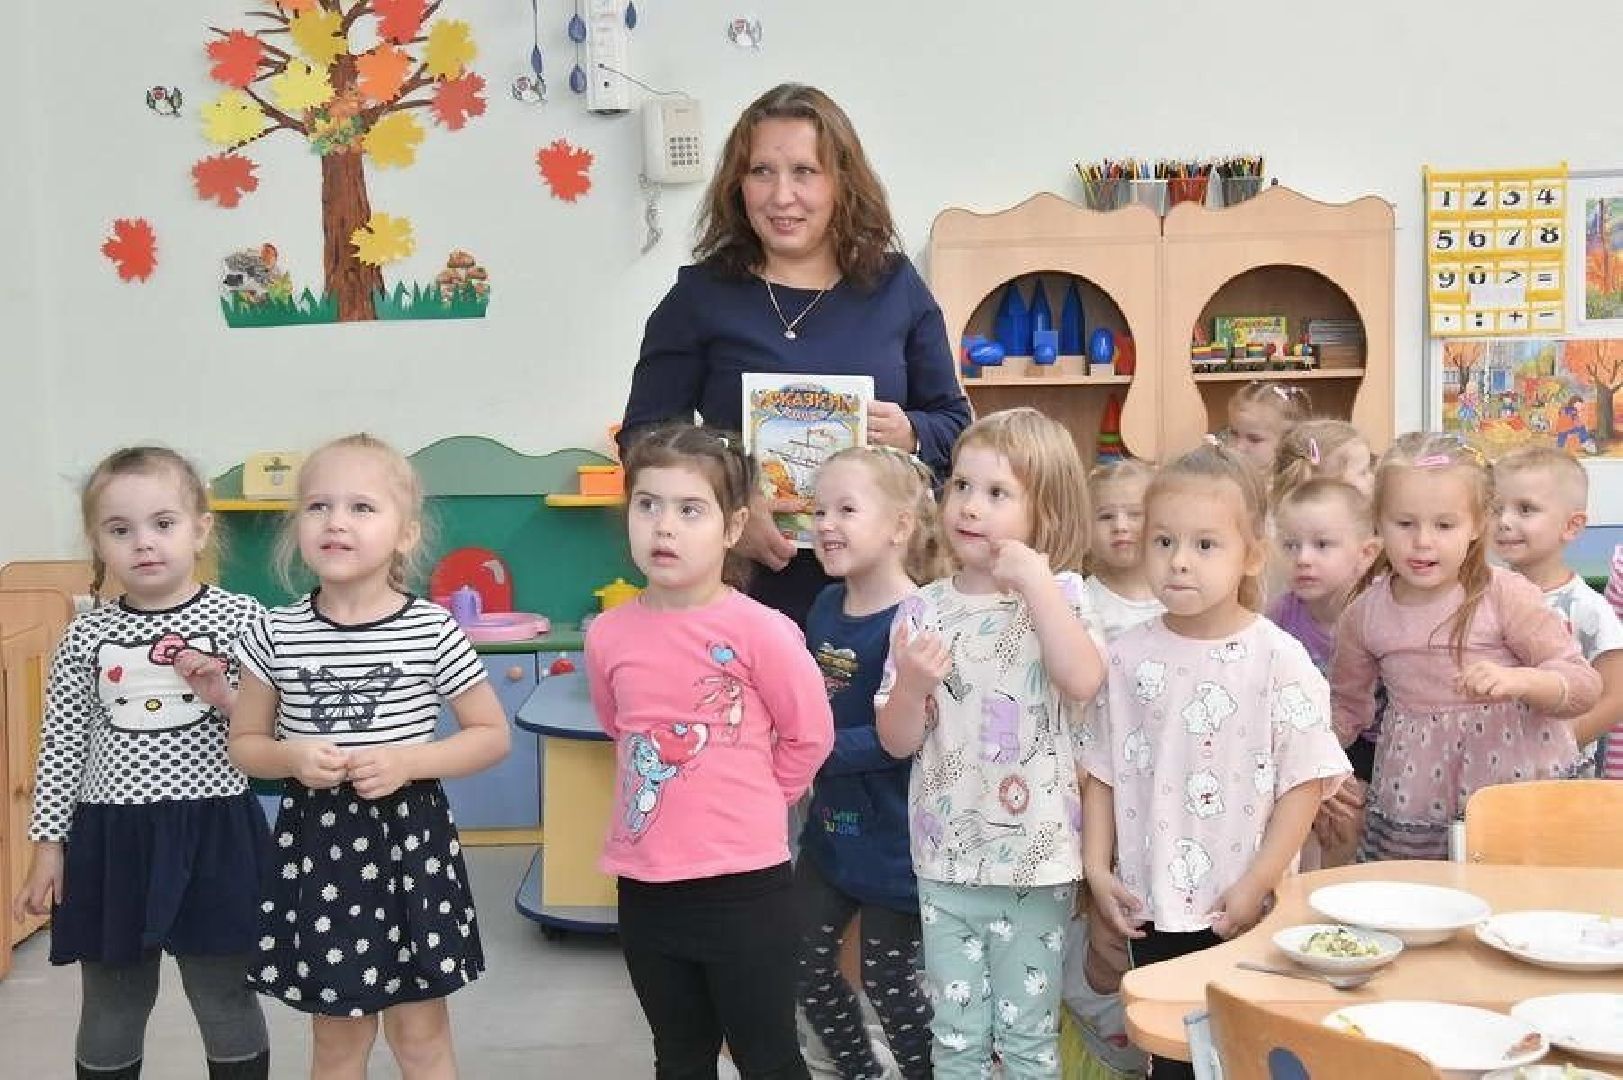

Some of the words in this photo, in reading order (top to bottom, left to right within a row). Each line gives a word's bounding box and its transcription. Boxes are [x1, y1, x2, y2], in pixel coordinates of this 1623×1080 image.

[1443, 191, 1450, 207] 1
[1472, 191, 1488, 206] 2
[1536, 189, 1554, 205] 4
[1437, 230, 1453, 248] 5
[1468, 230, 1486, 248] 6
[1540, 227, 1559, 243] 8
[1438, 271, 1455, 288] 9
[1468, 265, 1486, 285] 0
